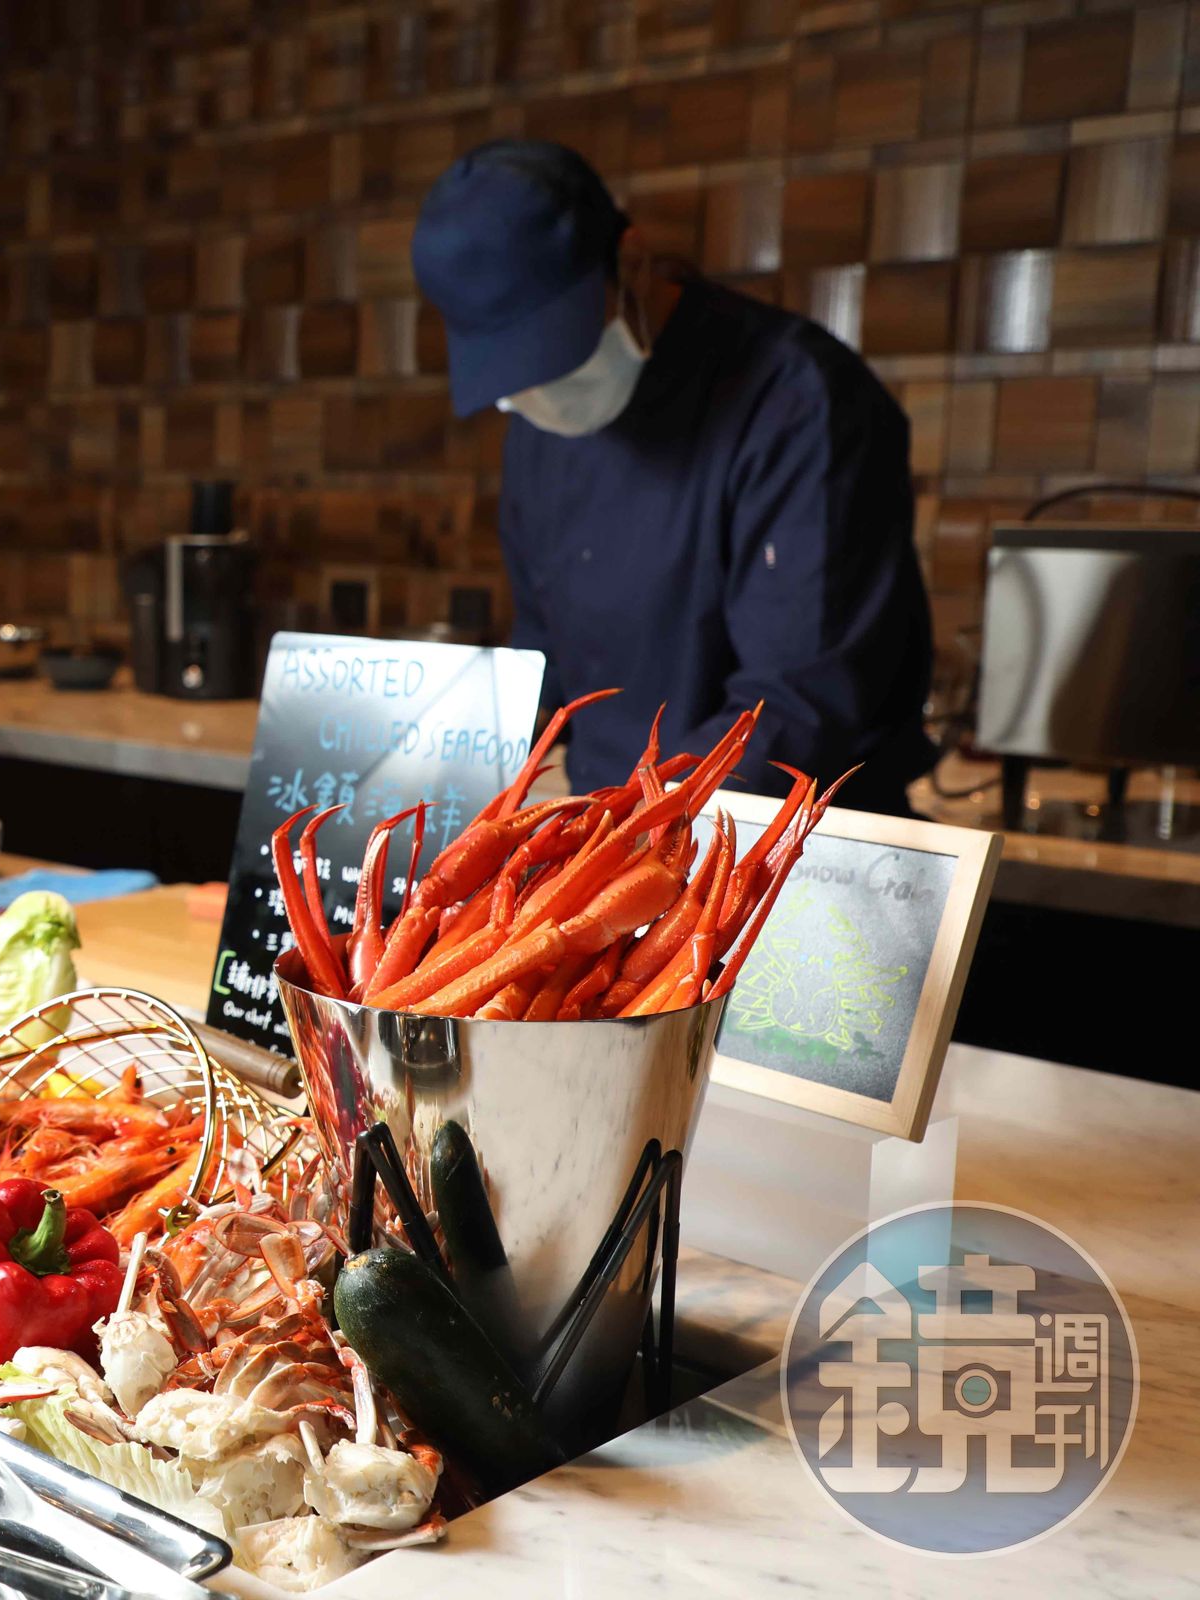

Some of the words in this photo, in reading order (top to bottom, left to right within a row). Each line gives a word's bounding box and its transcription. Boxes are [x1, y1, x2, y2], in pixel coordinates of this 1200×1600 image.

[281, 648, 425, 698] ASSORTED
[319, 714, 420, 754] CHILLED
[424, 721, 529, 773] SEAFOOD
[863, 850, 936, 902] Crab
